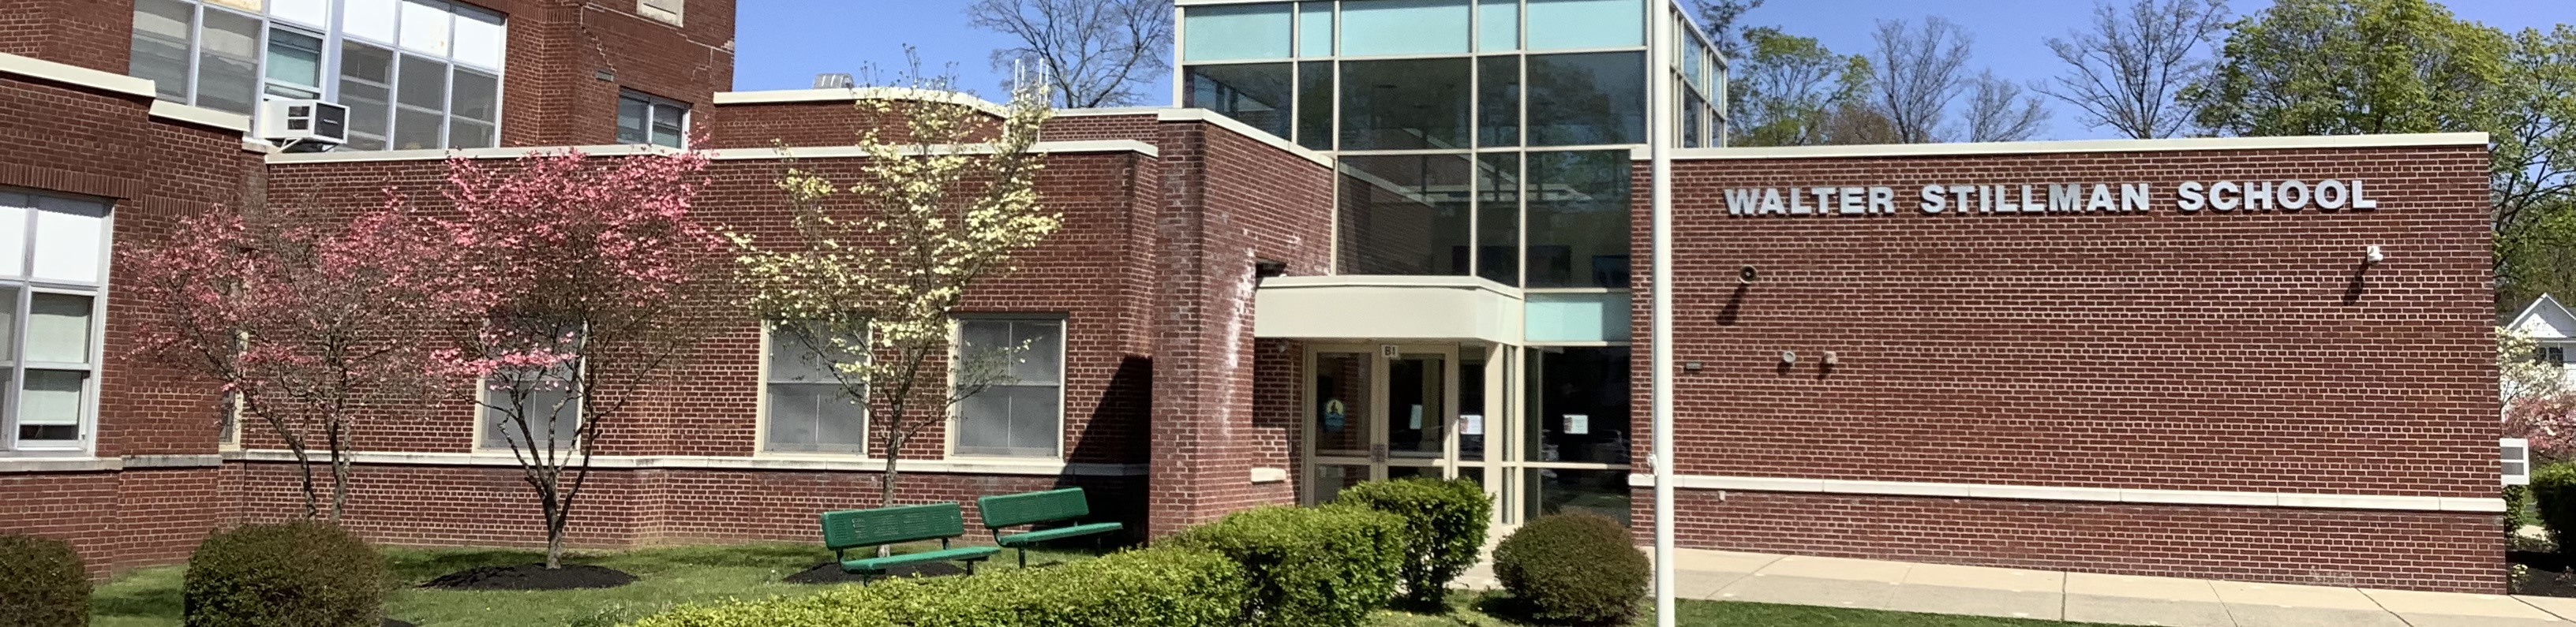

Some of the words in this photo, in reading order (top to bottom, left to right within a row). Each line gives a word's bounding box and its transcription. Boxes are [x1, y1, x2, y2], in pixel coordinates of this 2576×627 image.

[1724, 186, 1895, 216] WALTER
[1920, 183, 2150, 213] STILLMAN
[2177, 180, 2377, 211] SCHOOL
